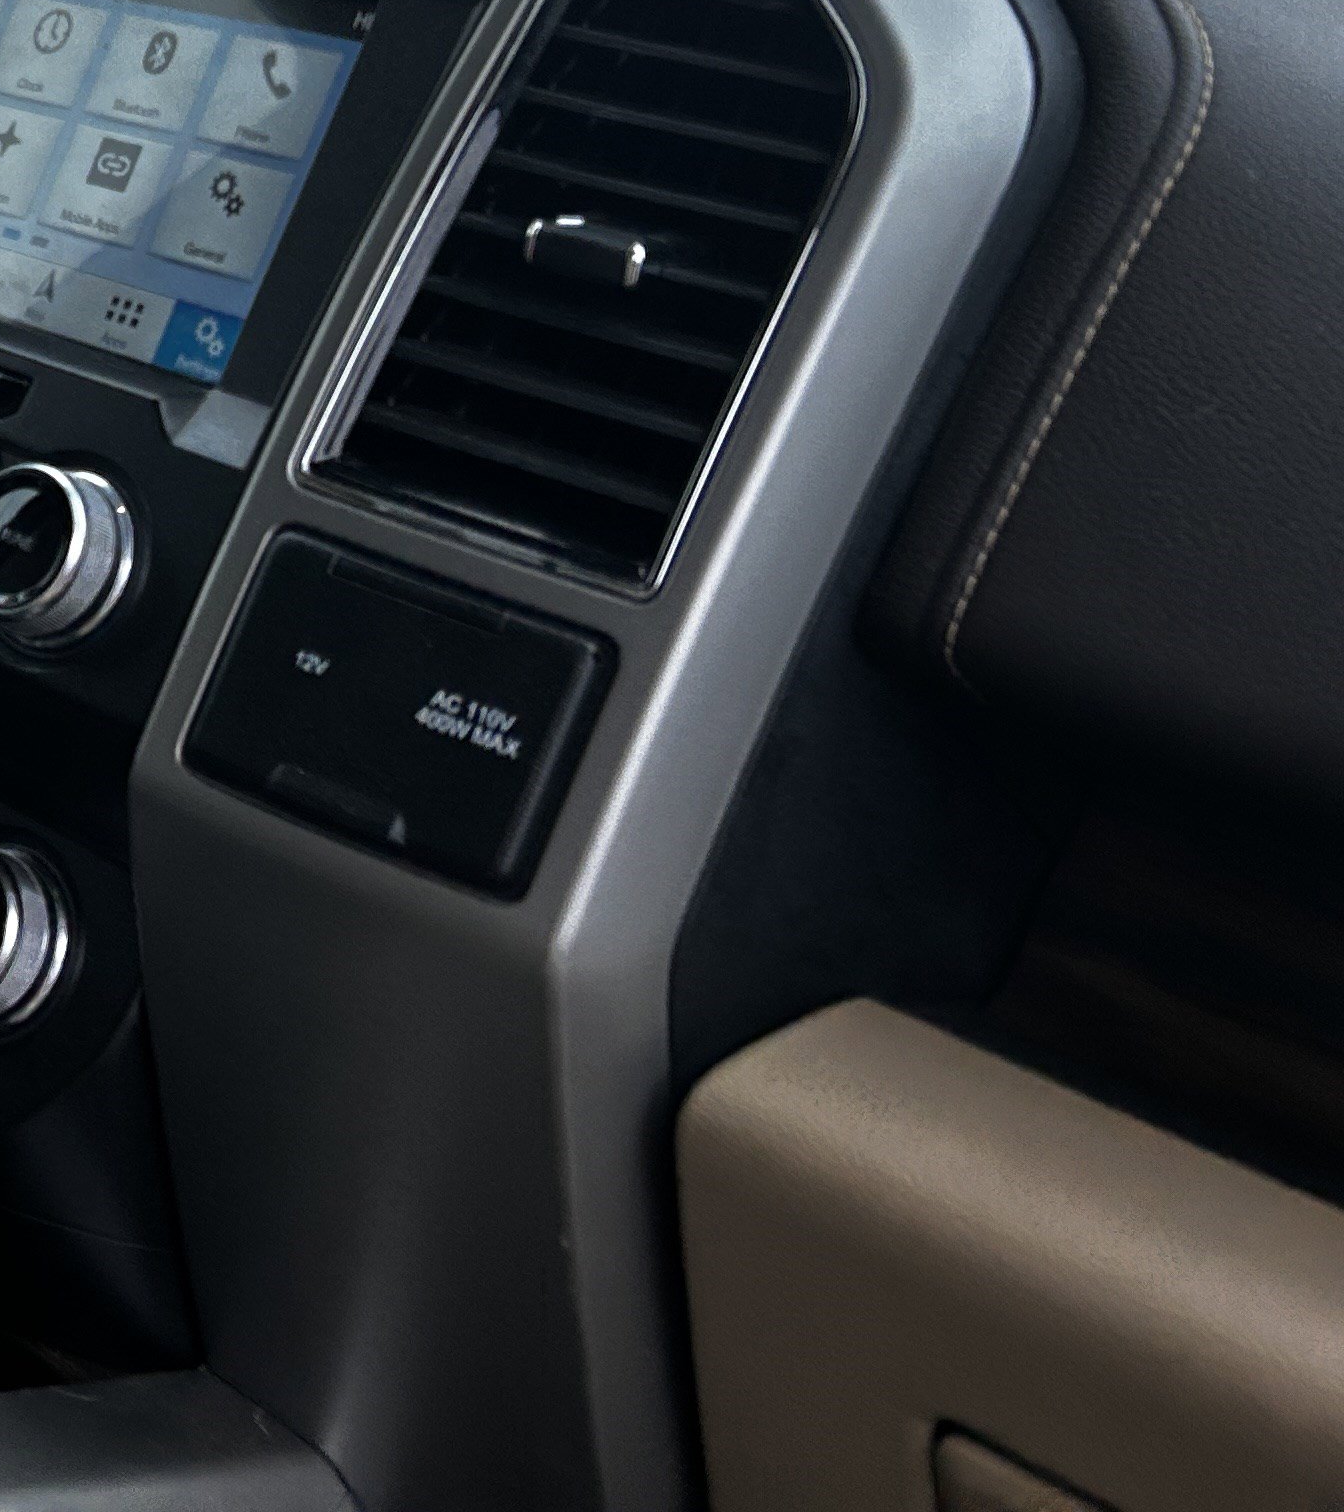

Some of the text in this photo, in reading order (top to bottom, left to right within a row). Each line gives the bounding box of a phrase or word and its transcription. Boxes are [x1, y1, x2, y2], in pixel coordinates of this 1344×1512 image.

[183, 241, 227, 264] General
[295, 649, 331, 675] 12V
[430, 689, 517, 733] AC 110V
[414, 707, 522, 759] 400W MAX
